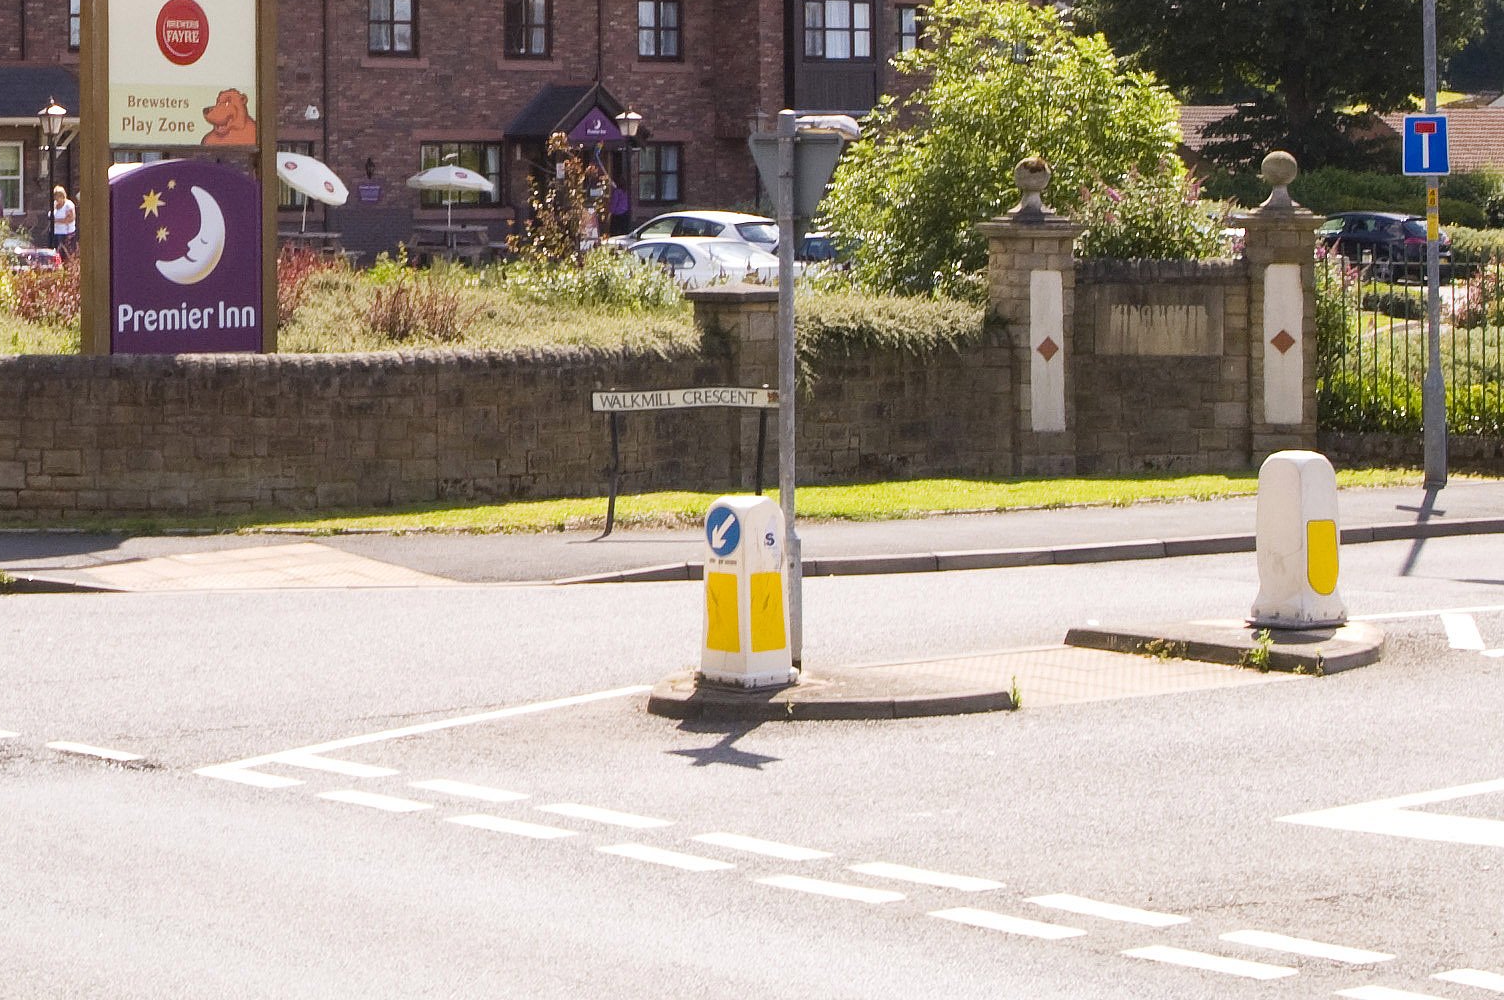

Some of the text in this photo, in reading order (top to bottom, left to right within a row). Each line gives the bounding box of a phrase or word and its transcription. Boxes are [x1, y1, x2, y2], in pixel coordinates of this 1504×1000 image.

[166, 29, 200, 44] FAYRE
[127, 95, 190, 109] Brewsters
[121, 115, 195, 136] Play Zone
[117, 300, 256, 333] Premier Inn
[599, 389, 758, 409] WALKMILL CRESCENT
